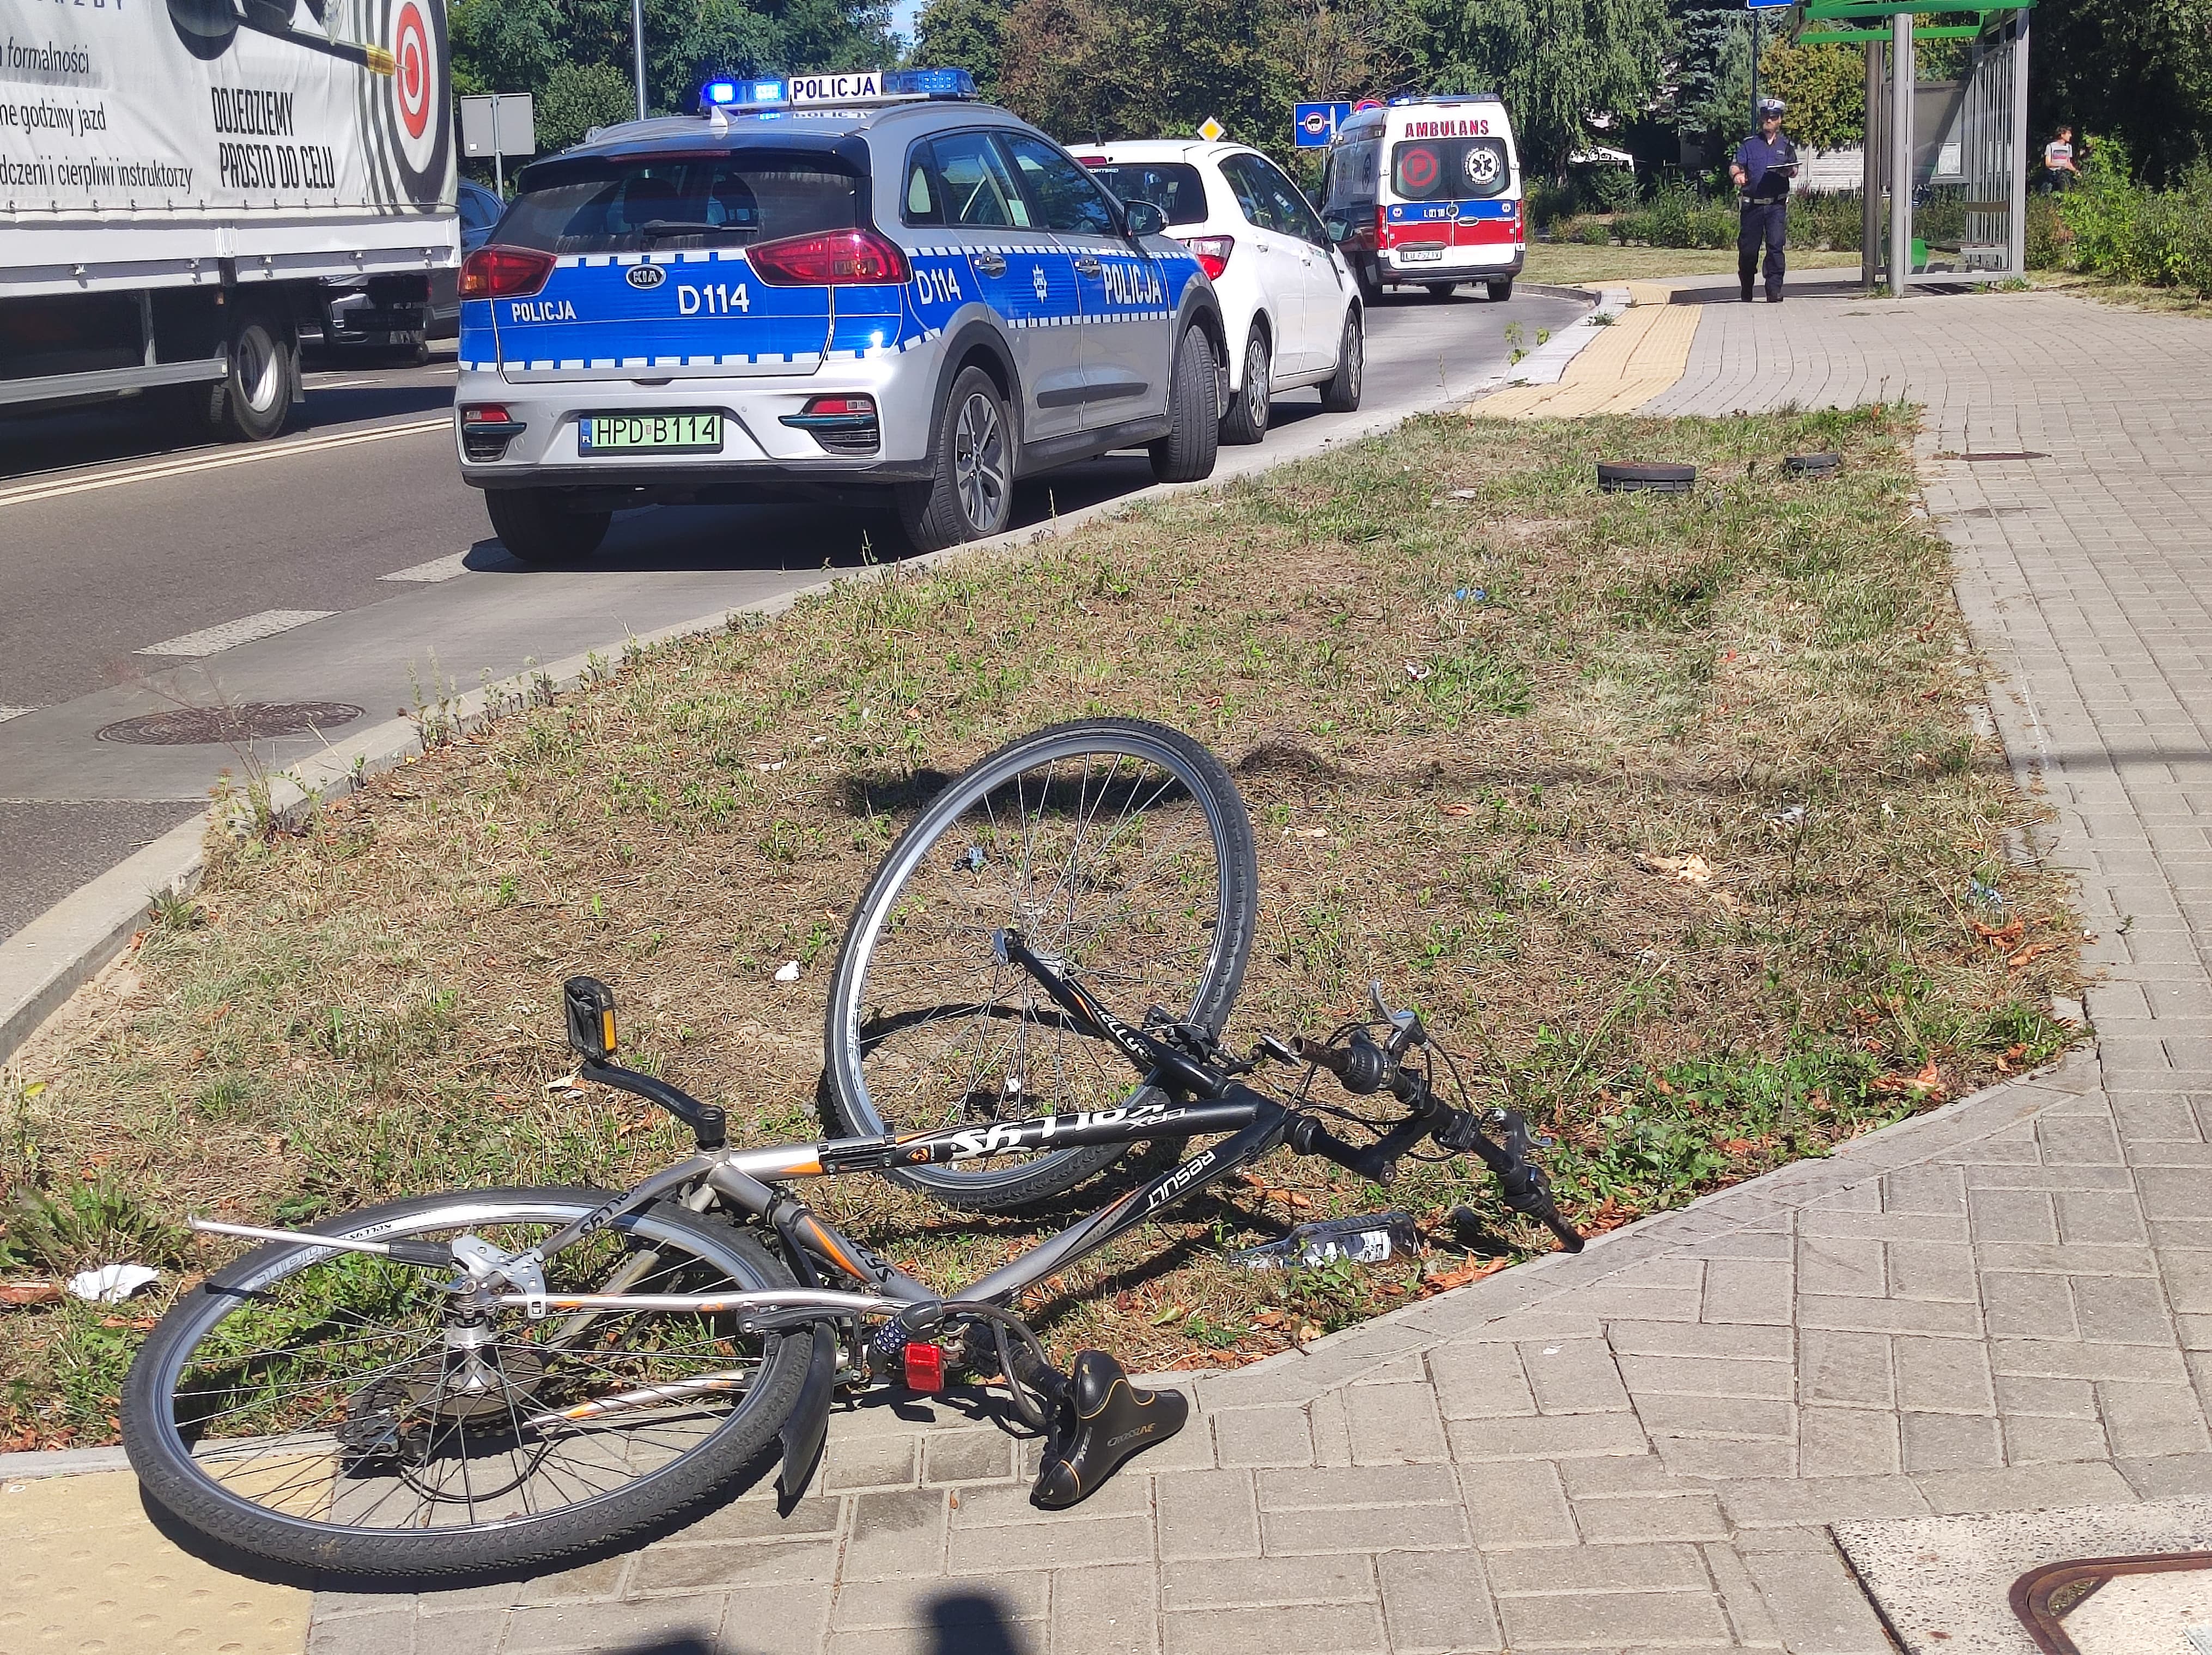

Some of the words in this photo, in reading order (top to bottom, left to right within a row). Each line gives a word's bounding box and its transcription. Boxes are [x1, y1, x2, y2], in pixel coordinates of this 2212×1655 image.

[8, 36, 89, 74] formalności
[793, 76, 876, 100] POLICJA
[21, 97, 74, 136] godziny
[76, 100, 107, 137] jazd
[211, 87, 294, 136] DOJEDZIEMY
[1405, 119, 1489, 137] AMBULANS
[48, 155, 54, 185] i
[58, 155, 114, 193] cierpliwi
[116, 157, 193, 194] instruktorzy
[219, 142, 276, 188] PROSTO
[276, 145, 300, 188] DO
[300, 146, 335, 189] CELU
[633, 270, 658, 283] KIA
[915, 268, 962, 305] D114
[1101, 264, 1163, 305] POLICJA
[511, 300, 578, 323] POLICJA
[677, 283, 750, 315] D114
[598, 418, 643, 445] HPD
[654, 416, 715, 443] B114
[1126, 1108, 1186, 1131] CRX
[1145, 1150, 1216, 1212] RESULT
